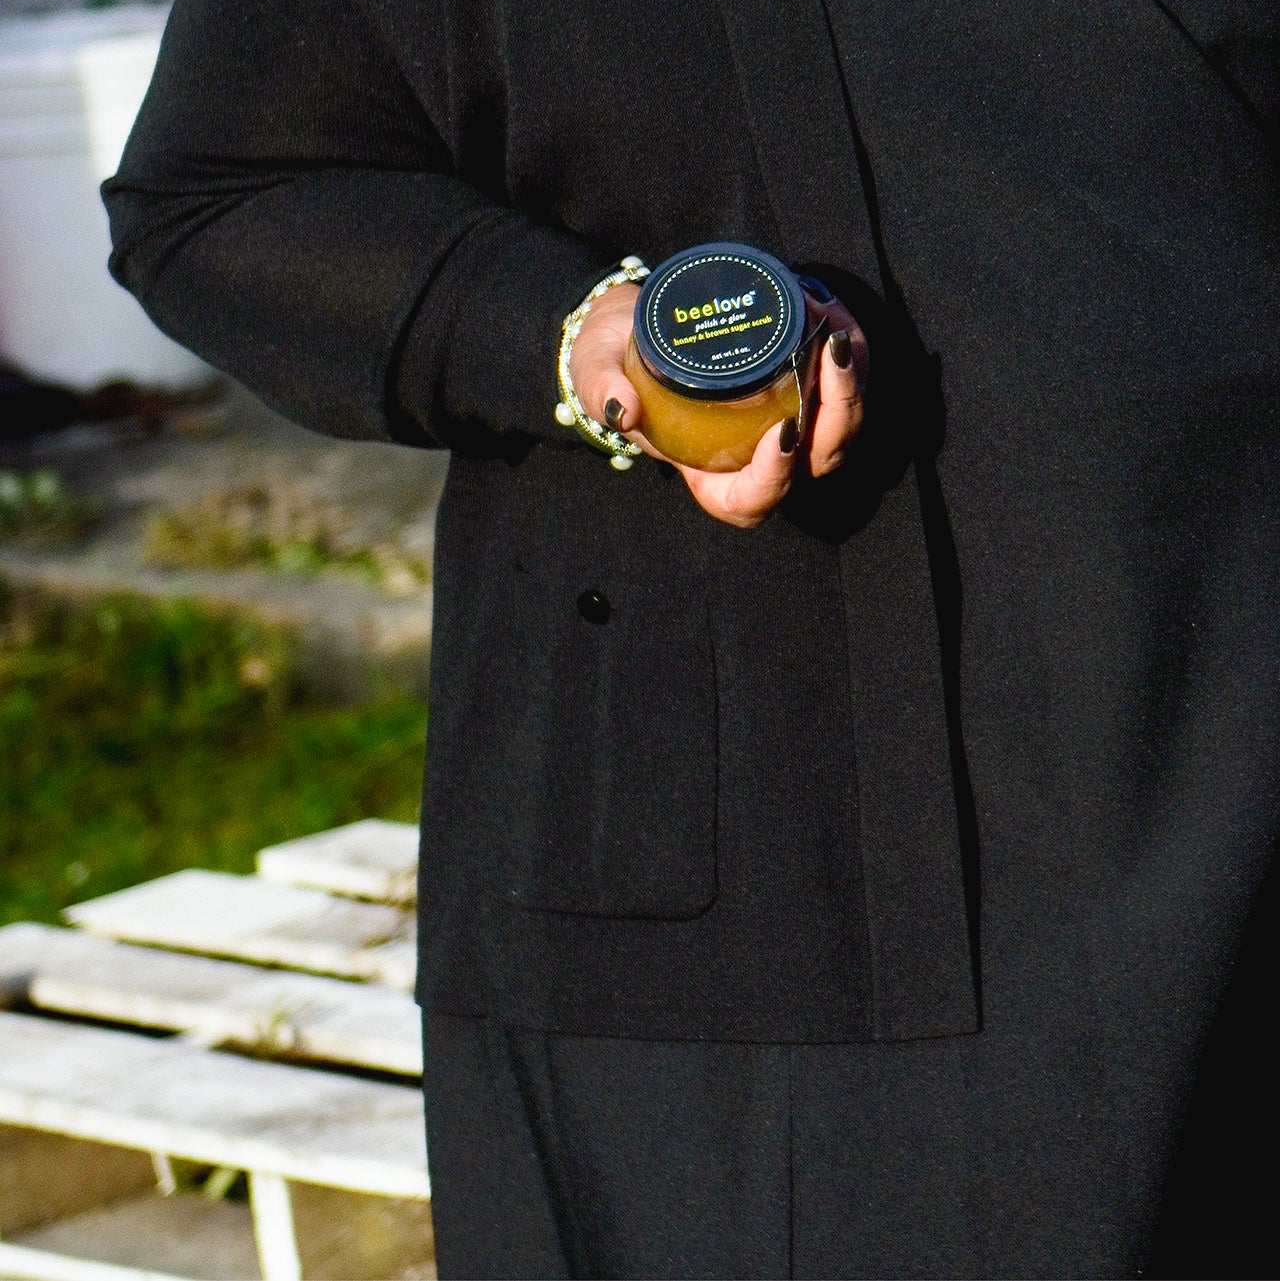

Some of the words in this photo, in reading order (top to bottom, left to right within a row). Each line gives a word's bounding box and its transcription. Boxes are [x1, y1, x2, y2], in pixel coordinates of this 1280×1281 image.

[673, 334, 697, 347] honey
[704, 329, 730, 340] brown
[730, 323, 751, 333] sugar
[752, 315, 773, 327] scrub
[695, 317, 719, 333] polish
[728, 313, 747, 325] glow
